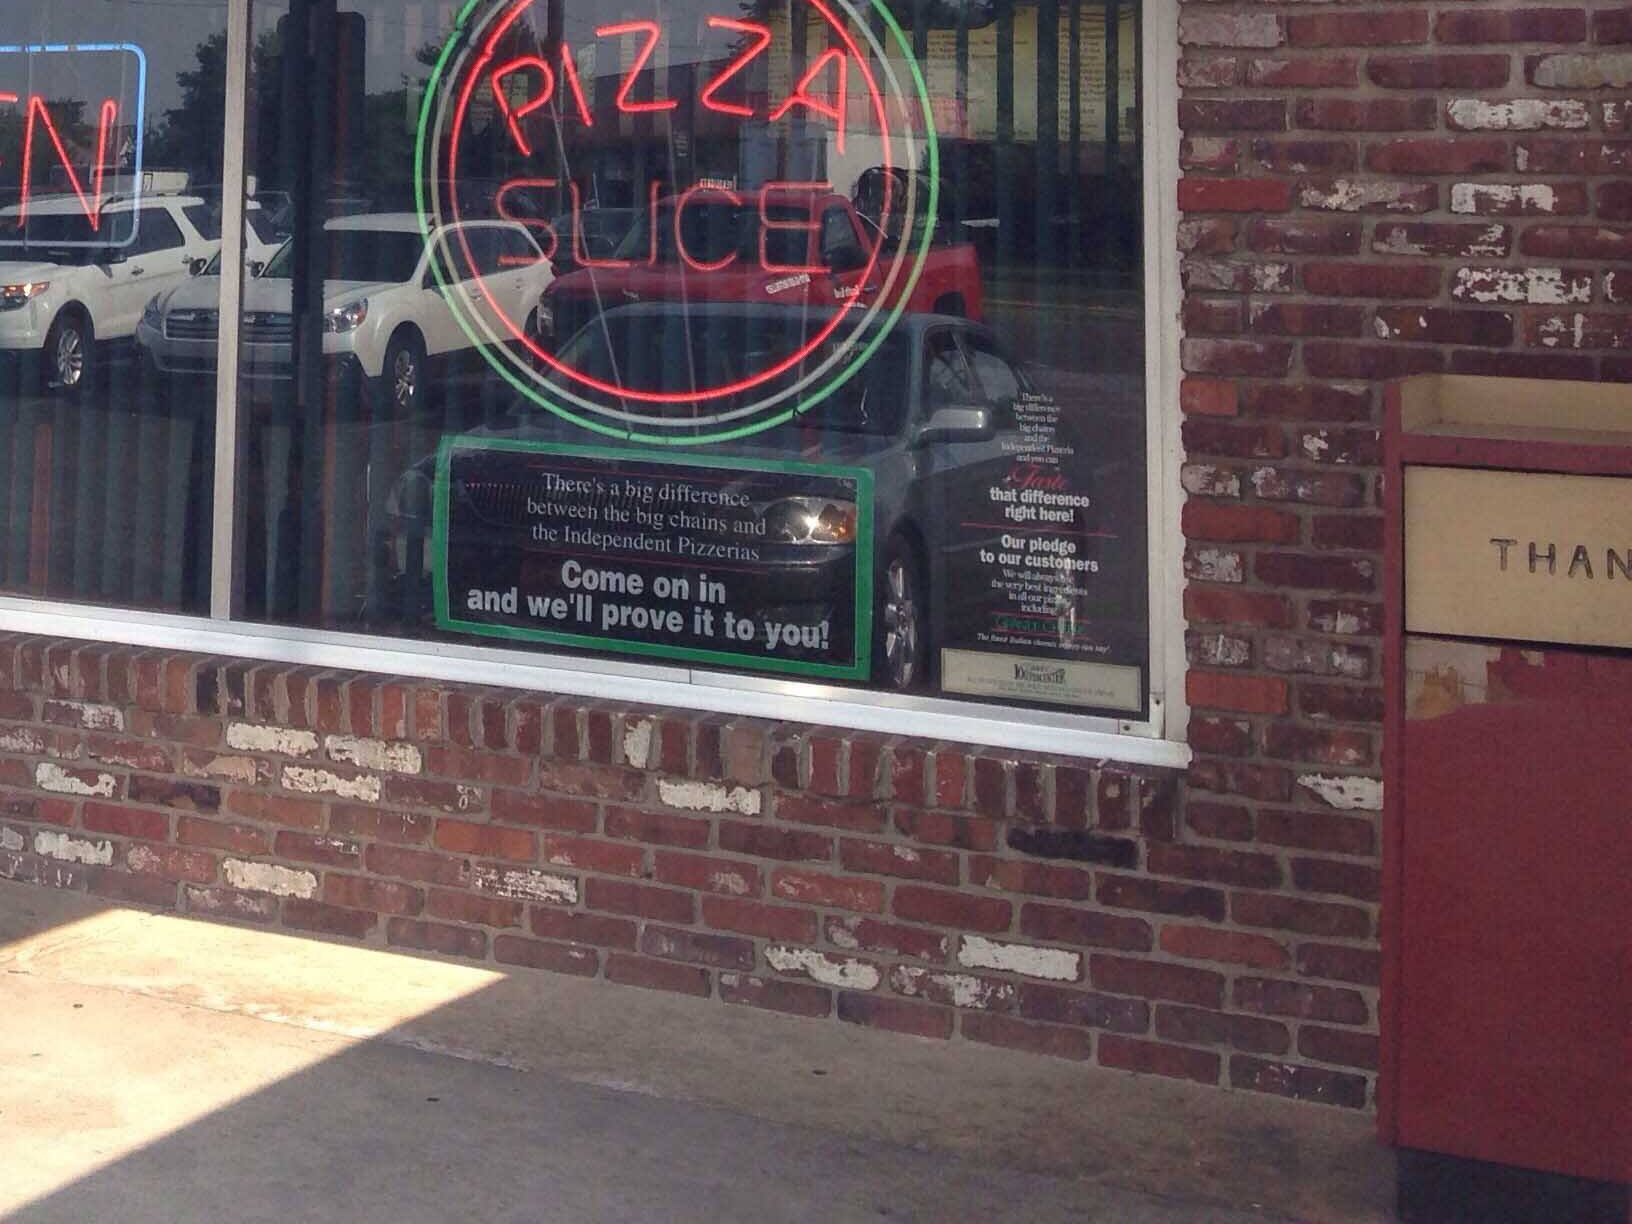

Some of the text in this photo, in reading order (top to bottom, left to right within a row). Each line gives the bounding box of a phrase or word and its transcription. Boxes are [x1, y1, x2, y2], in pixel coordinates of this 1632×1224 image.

[489, 15, 848, 156] PIZZA
[496, 178, 834, 275] SLICE
[542, 472, 750, 508] There's a big difference
[990, 486, 1090, 508] that difference
[527, 497, 766, 536] between the big chains and
[1004, 505, 1075, 523] right here!
[531, 523, 760, 561] the Independent Pizzerias
[979, 549, 1099, 572] to our customers
[1001, 534, 1077, 555] Our pledge
[561, 559, 726, 605] Come on in
[467, 586, 830, 650] and we'll prove it to you!
